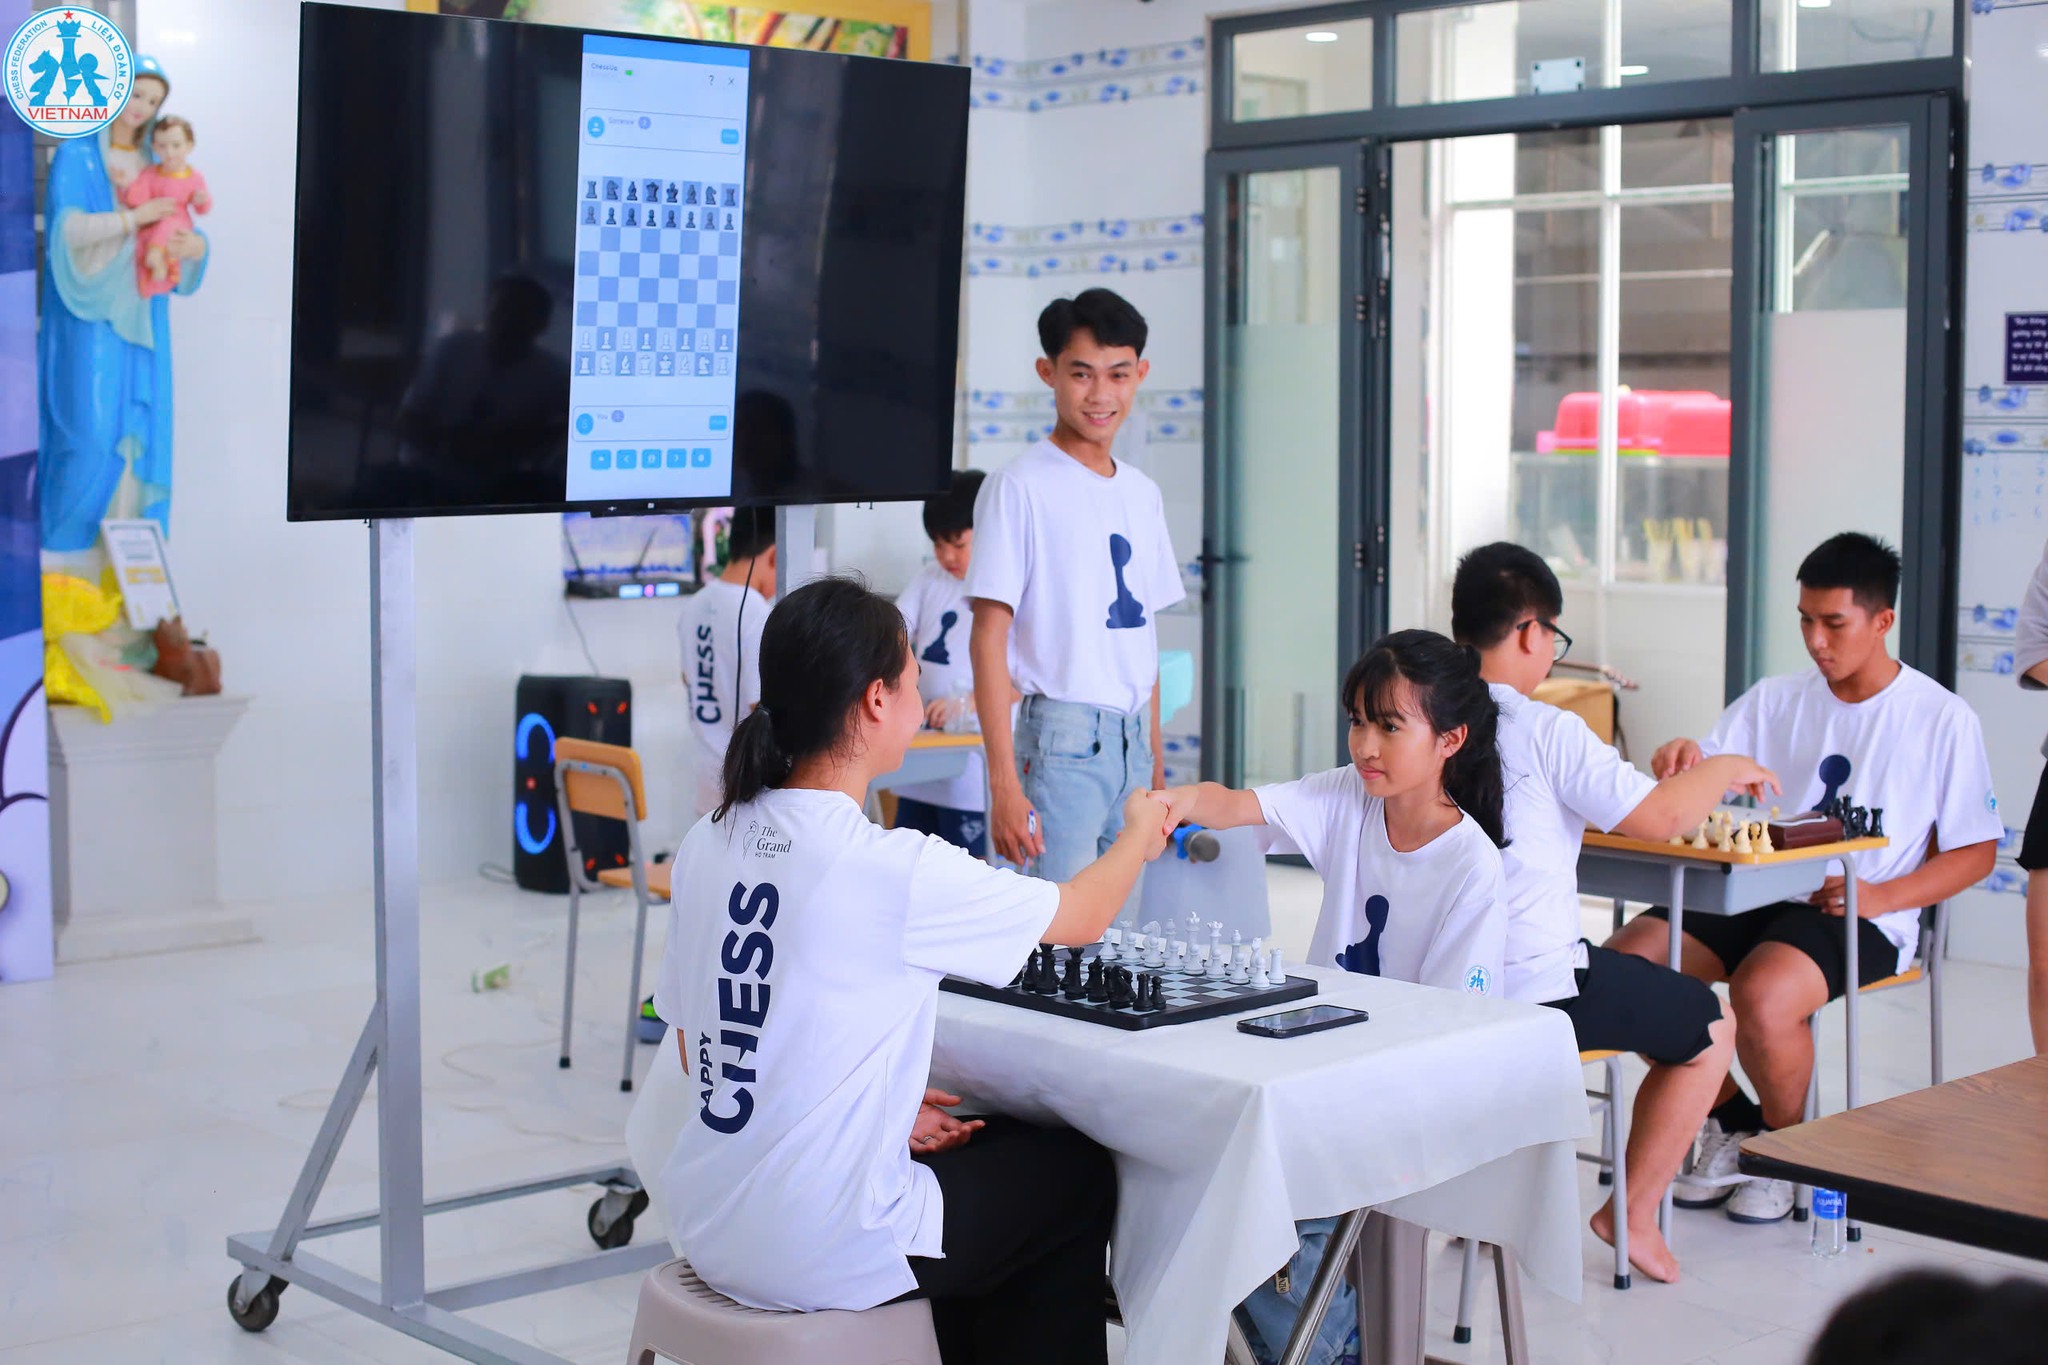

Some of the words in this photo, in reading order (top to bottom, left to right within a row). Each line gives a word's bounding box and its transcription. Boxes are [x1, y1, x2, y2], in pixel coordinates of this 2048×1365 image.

[696, 624, 721, 724] CHESS
[756, 838, 791, 853] Grand
[761, 826, 777, 837] The
[700, 881, 780, 1135] CHESS
[699, 1031, 714, 1110] APPY
